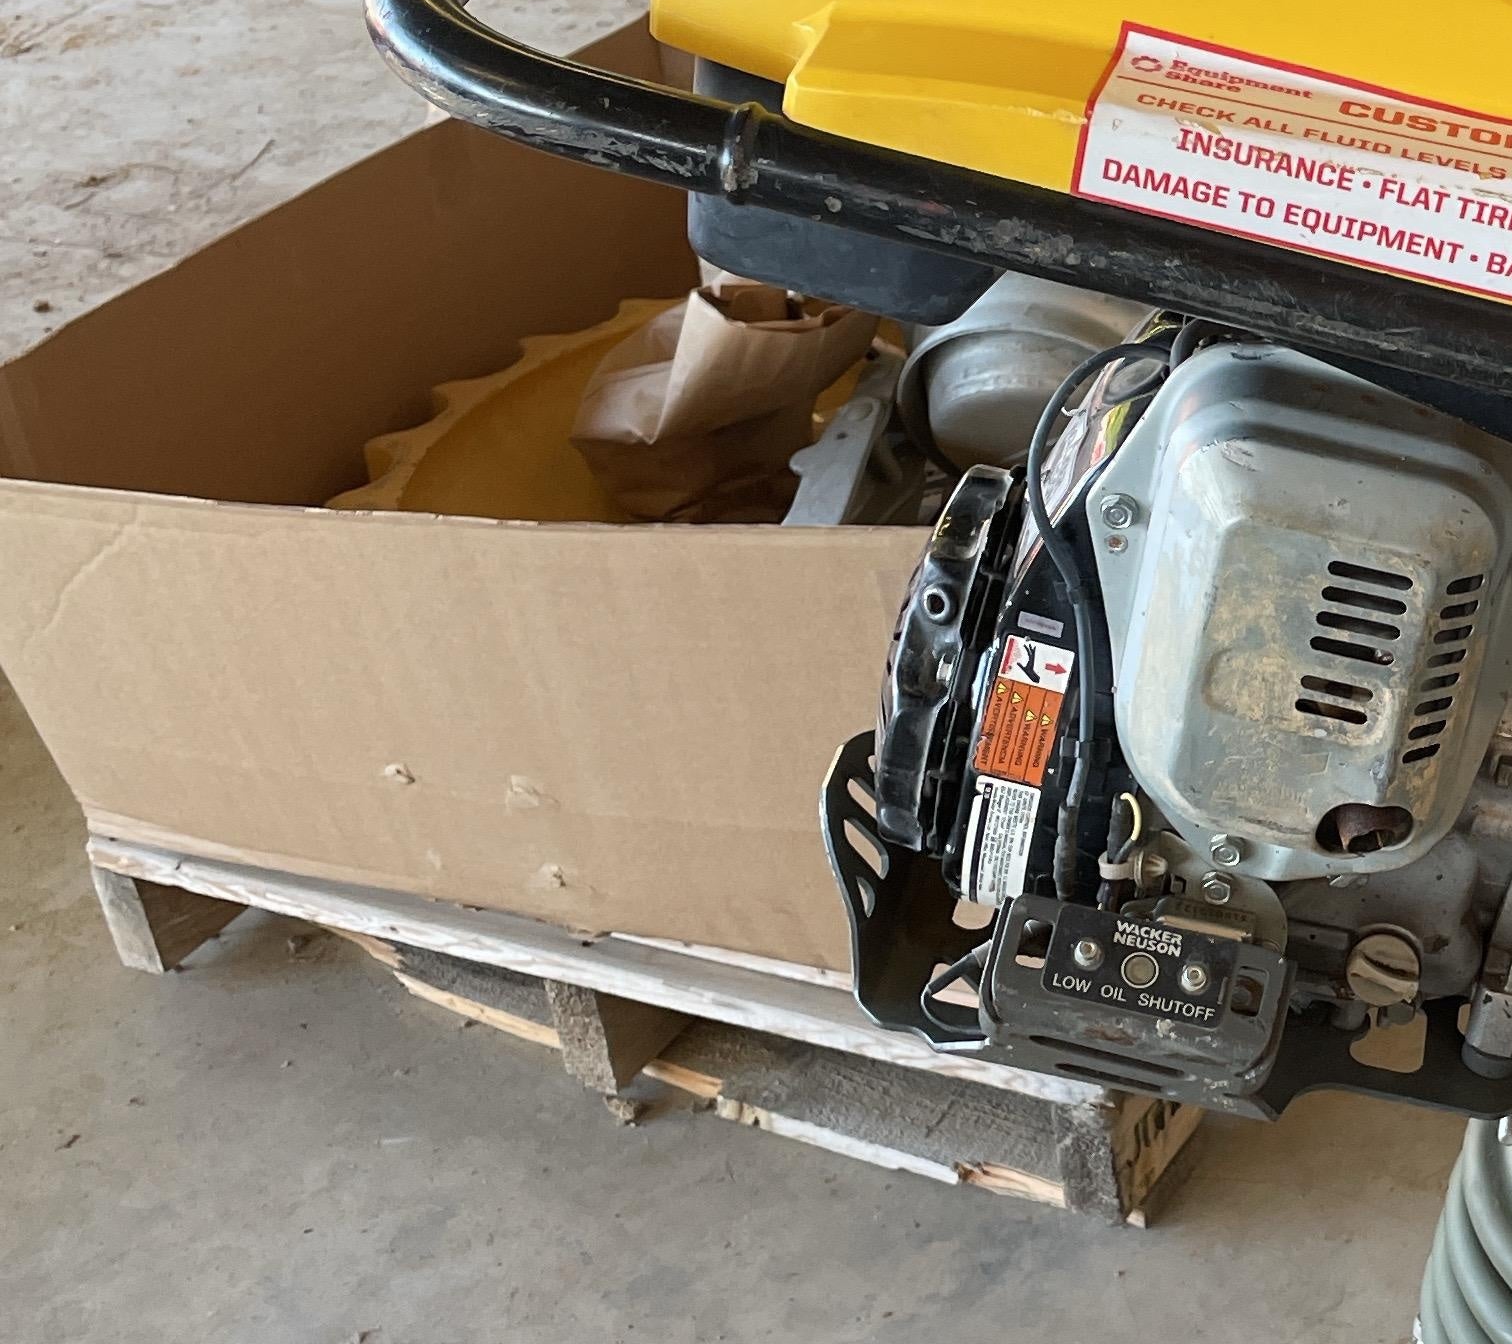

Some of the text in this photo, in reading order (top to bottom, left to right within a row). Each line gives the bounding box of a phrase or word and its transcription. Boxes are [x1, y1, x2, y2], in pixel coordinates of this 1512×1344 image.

[1164, 70, 1242, 94] Share
[1168, 59, 1314, 99] Equipment
[1136, 93, 1237, 123] CHECK
[1243, 116, 1295, 136] ALL
[1302, 127, 1393, 156] FLUID
[1400, 147, 1508, 181] LEVELS
[1176, 127, 1355, 193] INSURANCE
[1378, 179, 1451, 215] FLAT
[1102, 157, 1231, 209] DAMAGE
[1238, 190, 1276, 220] TO
[1283, 205, 1465, 265] EQUIPMENT
[1014, 722, 1032, 766] WARNING
[1032, 727, 1049, 769] WARNING
[1113, 930, 1182, 959] NEUSON
[1115, 919, 1184, 947] WACKER
[1052, 972, 1217, 1023] LOW OIL SHUTOFF
